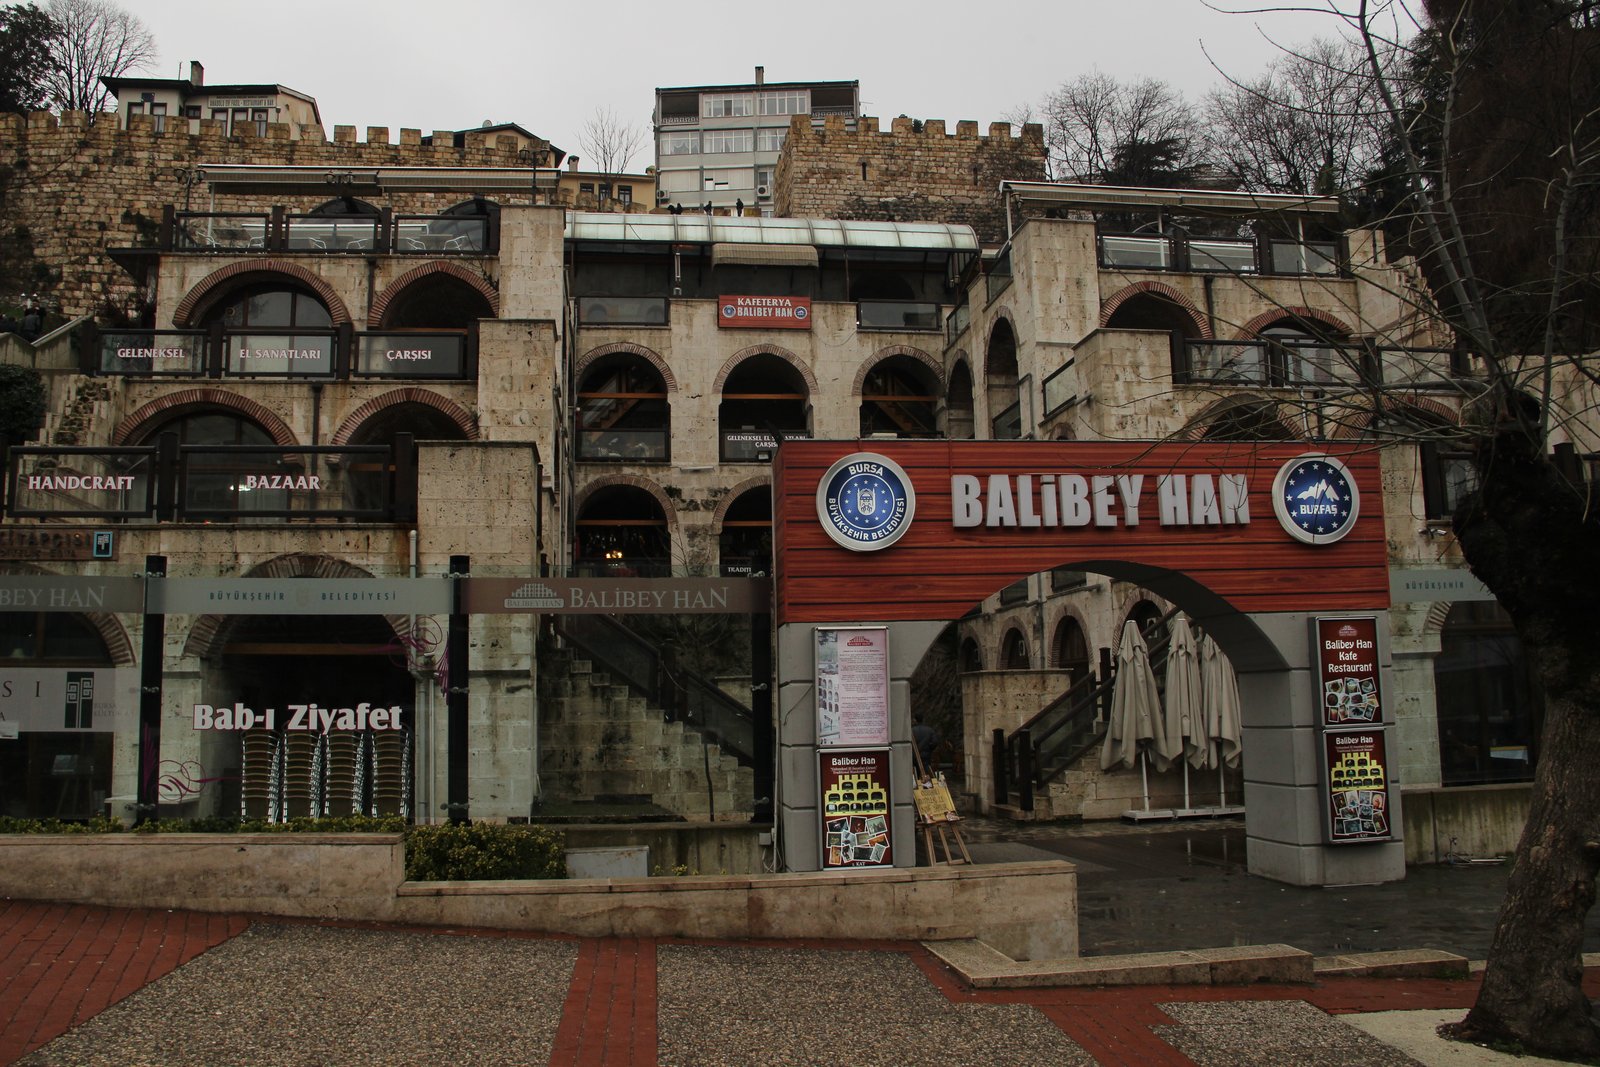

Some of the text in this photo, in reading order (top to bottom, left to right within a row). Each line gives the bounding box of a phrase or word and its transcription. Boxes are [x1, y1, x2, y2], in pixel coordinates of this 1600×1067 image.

[737, 297, 792, 307] KAFETERYA
[775, 308, 793, 318] HAN
[117, 347, 185, 359] GELENEKSEL
[239, 348, 321, 360] EL SANATLARI
[386, 349, 432, 362] ÇARŞISI
[848, 463, 884, 477] BURSA
[28, 475, 135, 490] HANDCRAFT
[246, 475, 320, 490] BAZAAR
[1157, 473, 1250, 527] HAN
[1299, 504, 1338, 517] BURFAŞ
[828, 497, 904, 541] BÜYÜKŞEHİR BELEDİYESİ
[48, 585, 107, 607] HAN
[210, 590, 396, 601] BÜYÜKŞEHİR BELEDİYESİ
[673, 587, 729, 608] HAN
[1325, 639, 1373, 650] Balibey Han
[1339, 651, 1358, 661] Kafe
[1328, 662, 1373, 673] Restaurant
[287, 702, 403, 735] Ziyafet
[1335, 736, 1374, 745] Balibey Han
[831, 756, 876, 766] Balibey Han
